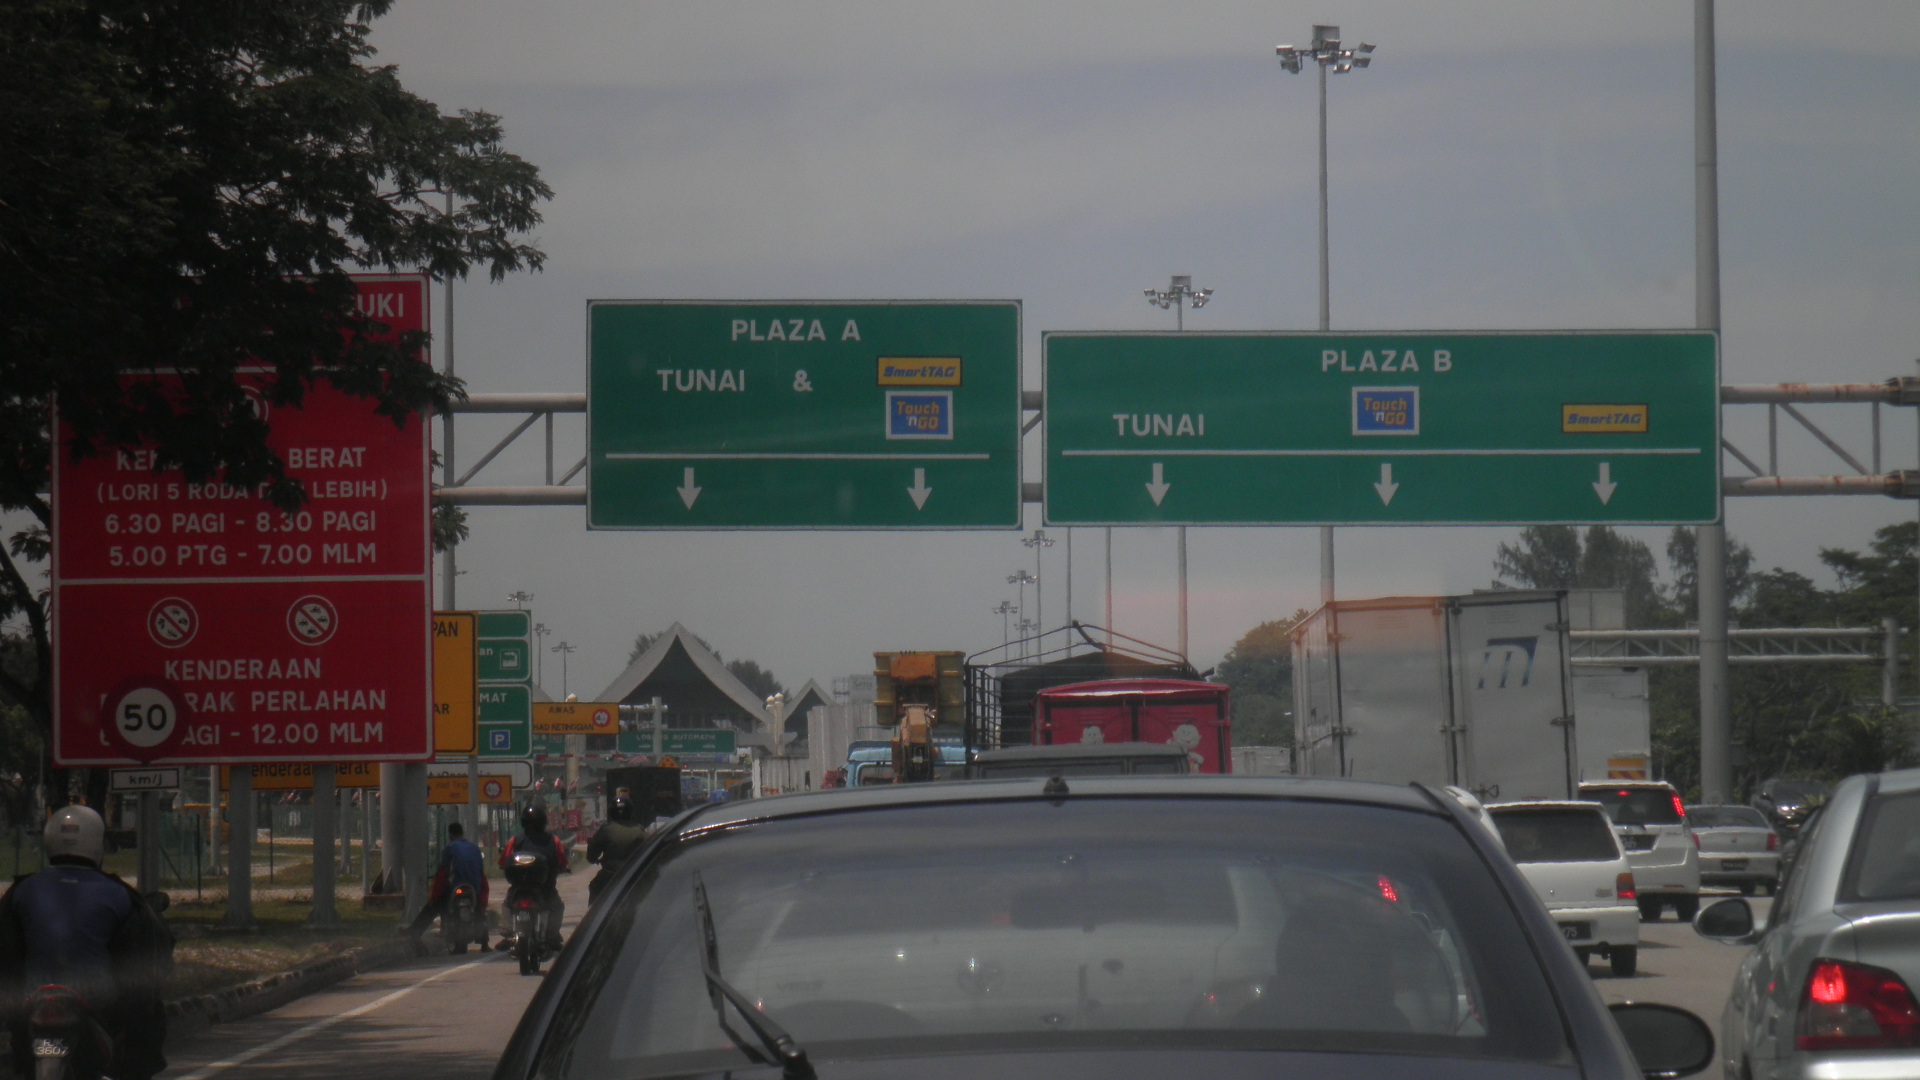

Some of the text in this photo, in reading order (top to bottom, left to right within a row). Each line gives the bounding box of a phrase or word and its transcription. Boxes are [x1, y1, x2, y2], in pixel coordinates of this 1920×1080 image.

[730, 318, 862, 342] PLAZA A
[883, 365, 957, 378] SmartTAG
[1321, 349, 1453, 373] PLAZA B
[656, 369, 814, 392] TUNAI &
[896, 400, 940, 416] Touch
[1363, 397, 1408, 412] Touch
[1112, 413, 1204, 437] TUNAI
[1567, 413, 1642, 425] SmartTAG
[288, 446, 367, 469] BERAT
[96, 482, 159, 503] (LORI
[166, 482, 181, 500] 5
[187, 482, 250, 500] RODA
[312, 479, 388, 501] LEBIH)
[105, 513, 161, 534] 6.30
[171, 512, 225, 534] PAGI
[256, 511, 313, 533] 8.30
[322, 510, 377, 532] PAGI
[108, 545, 167, 567] 5.00
[177, 544, 228, 566] PTG
[258, 543, 313, 565] 7.00
[322, 542, 377, 564] MLM
[164, 657, 322, 681] KENDERAAN
[251, 689, 387, 713] PERLAHAN
[548, 706, 576, 714] AWAS
[123, 703, 168, 732] 50
[180, 724, 220, 746] AGI
[251, 722, 319, 744] 12.00
[329, 721, 384, 744] MLM
[128, 773, 163, 787] km/j
[36, 1046, 69, 1056] 3607
